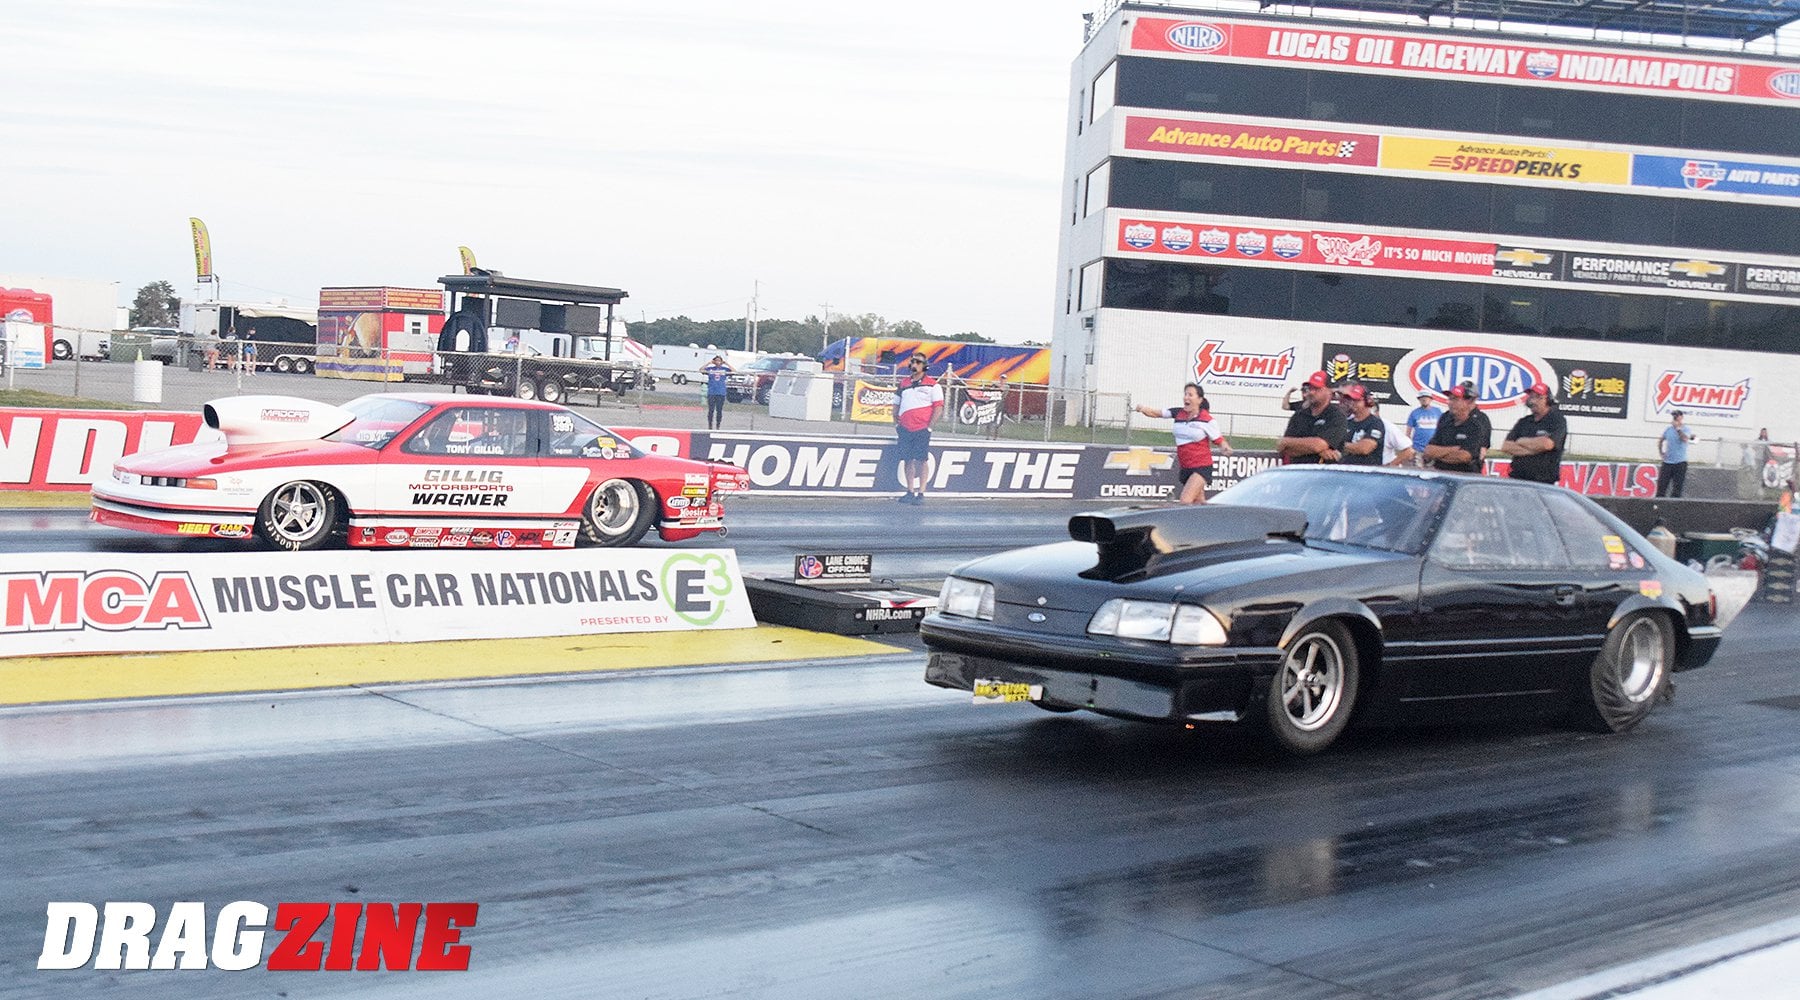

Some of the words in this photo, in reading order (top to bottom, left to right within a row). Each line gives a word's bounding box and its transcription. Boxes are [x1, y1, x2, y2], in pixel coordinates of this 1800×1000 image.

[1170, 23, 1222, 48] NHRA
[1267, 30, 1349, 61] LUCAS
[1355, 38, 1394, 65] OIL
[1401, 40, 1525, 75] RACEWAY
[1559, 54, 1734, 93] INDIANAPOLIS
[1774, 73, 1800, 97] NH
[1149, 126, 1231, 149] Advance
[1231, 133, 1287, 153] Auto
[1283, 138, 1337, 158] Parts
[1457, 144, 1496, 155] Advance
[1496, 147, 1520, 157] Auto
[1521, 149, 1547, 159] Parts
[1451, 155, 1581, 179] SPEEDPERKS
[1727, 169, 1761, 184] AUTO
[1761, 172, 1800, 187] PARTS
[1384, 246, 1402, 259] IT'S
[1405, 248, 1420, 260] SO
[1421, 250, 1452, 263] MUCH
[1455, 252, 1495, 265] MOWER
[1572, 256, 1670, 276] PERFORMANCE
[1492, 268, 1553, 281] CHEVROLET
[1572, 270, 1608, 281] VEHICLES
[1613, 274, 1636, 283] PARTS
[1746, 268, 1800, 285] PERFOR
[1667, 279, 1727, 292] CHEVROLET
[1206, 378, 1237, 387] RACING
[1238, 381, 1285, 389] EQUIPMENT
[1428, 354, 1525, 400] NHRA
[1558, 403, 1580, 411] LUCAS
[1591, 406, 1622, 414] RACEWAY
[446, 444, 471, 454] TONY
[474, 445, 501, 455] GILLIG
[707, 443, 883, 489] HOME
[984, 452, 1081, 490] THE
[424, 469, 503, 484] GILLIG
[408, 483, 514, 492] MOTORSPORTS
[1101, 484, 1175, 498] CHEVROLET
[412, 493, 508, 507] WAGNER
[825, 555, 843, 565] LANE
[844, 555, 869, 564] CHOICE
[3, 572, 205, 630] MCA
[212, 574, 377, 613] MUSCLE
[386, 573, 462, 608] CAR
[471, 569, 659, 606] NATIONALS
[580, 616, 651, 626] PRESENTED
[655, 615, 669, 625] BY
[866, 609, 912, 621] NHRA.com
